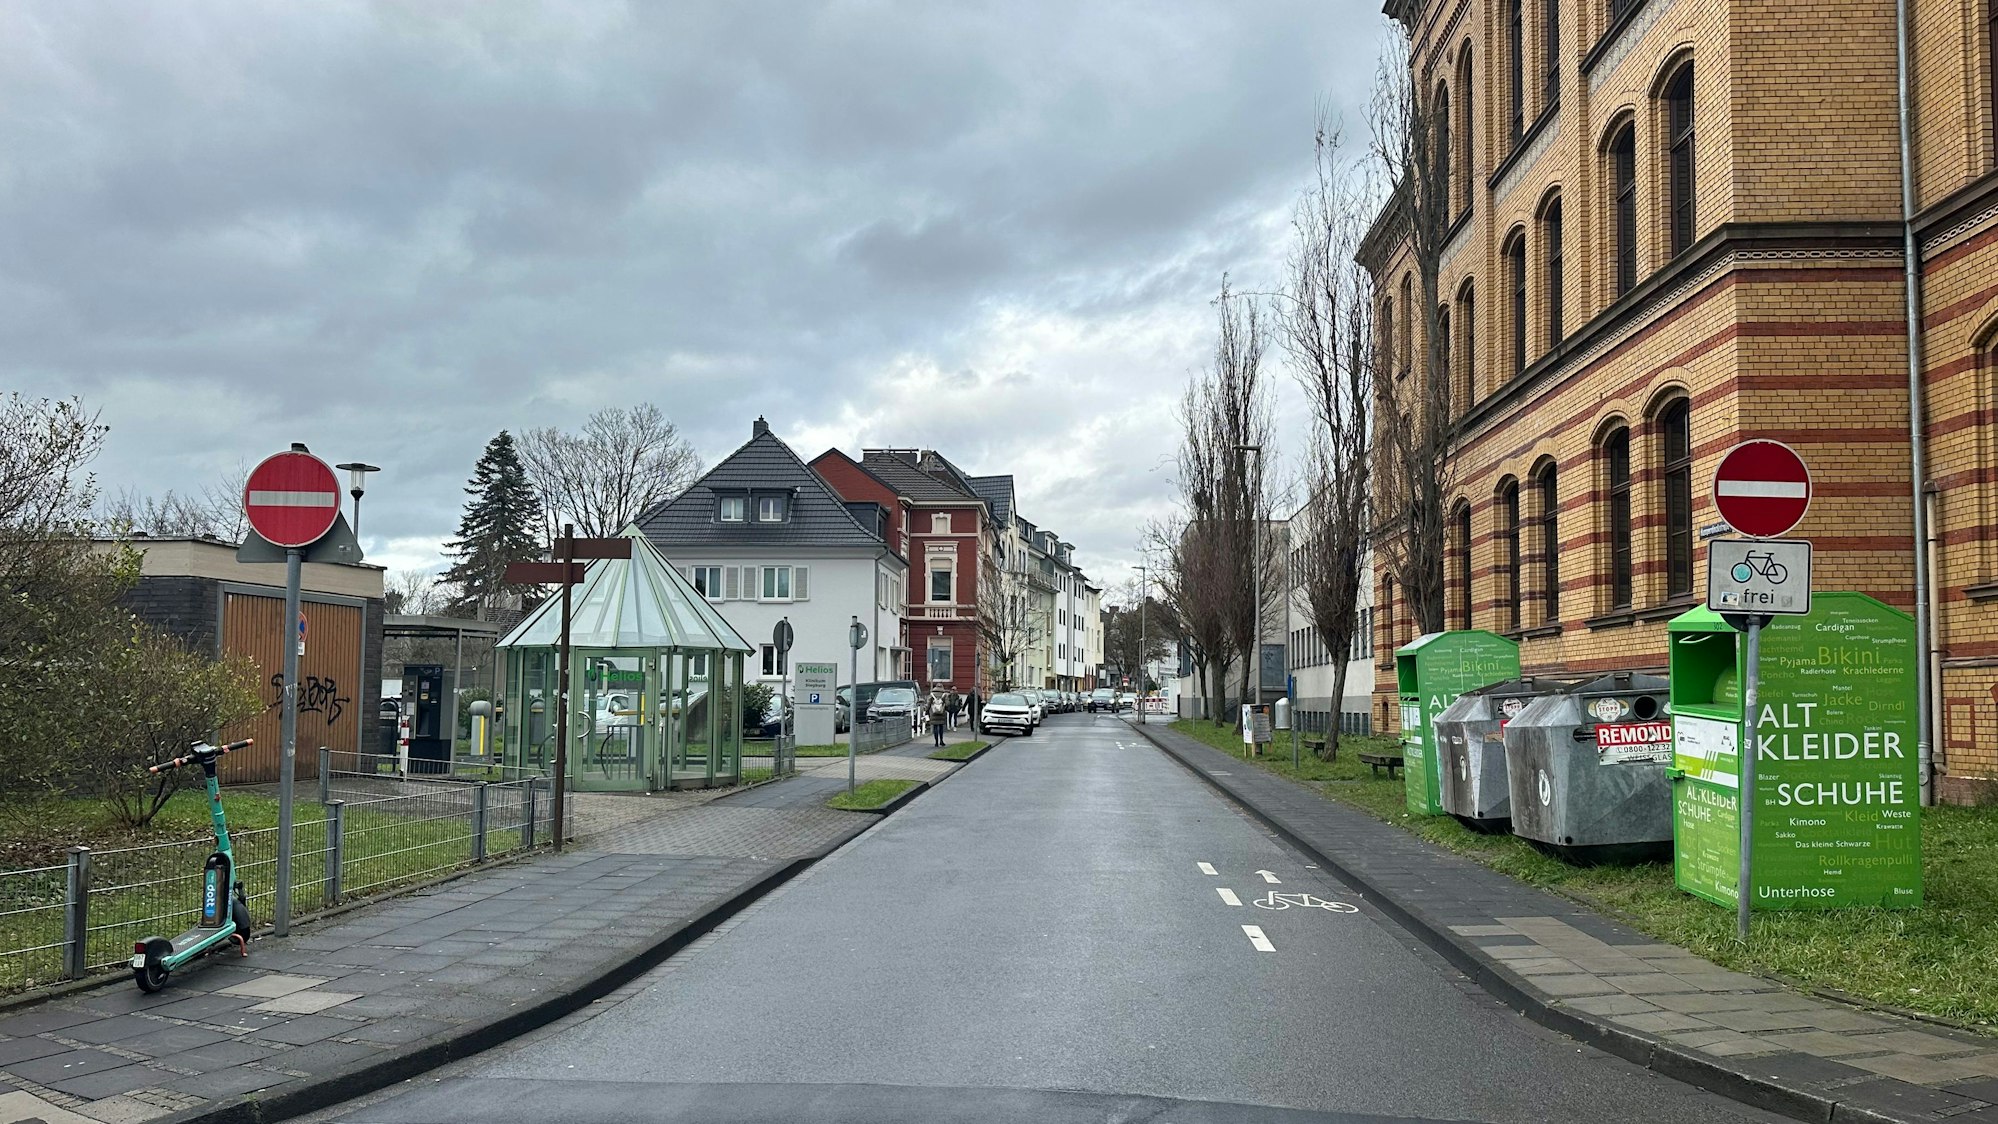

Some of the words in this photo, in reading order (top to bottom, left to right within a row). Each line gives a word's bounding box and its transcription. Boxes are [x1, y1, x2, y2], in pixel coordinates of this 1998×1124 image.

[1744, 588, 1774, 604] frei
[1815, 622, 1855, 633] Cardigan
[1818, 646, 1880, 665] Bikini
[1462, 659, 1501, 673] Bikini
[1779, 655, 1817, 668] Pyjama
[805, 665, 834, 674] Helios
[1761, 670, 1795, 680] Poncho
[1800, 667, 1837, 676] Radlerhose
[1843, 665, 1904, 676] Krachlederne
[601, 671, 644, 681] Helios
[1832, 684, 1853, 692] Mantel
[811, 694, 818, 703] P
[1823, 692, 1863, 707] Jacke
[1869, 700, 1905, 711] Dirndl
[1757, 702, 1818, 729] ALT
[1819, 716, 1844, 726] Chino
[1757, 731, 1905, 761] KLEIDER
[1758, 773, 1780, 781] Blazer
[1777, 781, 1904, 806] SCHUHE
[1765, 798, 1776, 806] BH
[1677, 799, 1712, 823] SCHUHE
[1845, 810, 1879, 822] Kleid
[1881, 809, 1912, 819] Weste
[1789, 817, 1827, 827] Kimono
[1775, 831, 1797, 839] Sakko
[1795, 840, 1810, 848] Das
[1811, 840, 1834, 848] kleine
[1835, 839, 1871, 848] Schwarze
[1875, 833, 1913, 850] Hut
[1819, 854, 1913, 869] Rollkragenpulli
[1823, 868, 1843, 876] Hemd
[1714, 880, 1740, 900] Kimono
[1758, 885, 1836, 899] Unterhose
[1893, 887, 1914, 895] Bluse
[206, 884, 216, 908] dott
